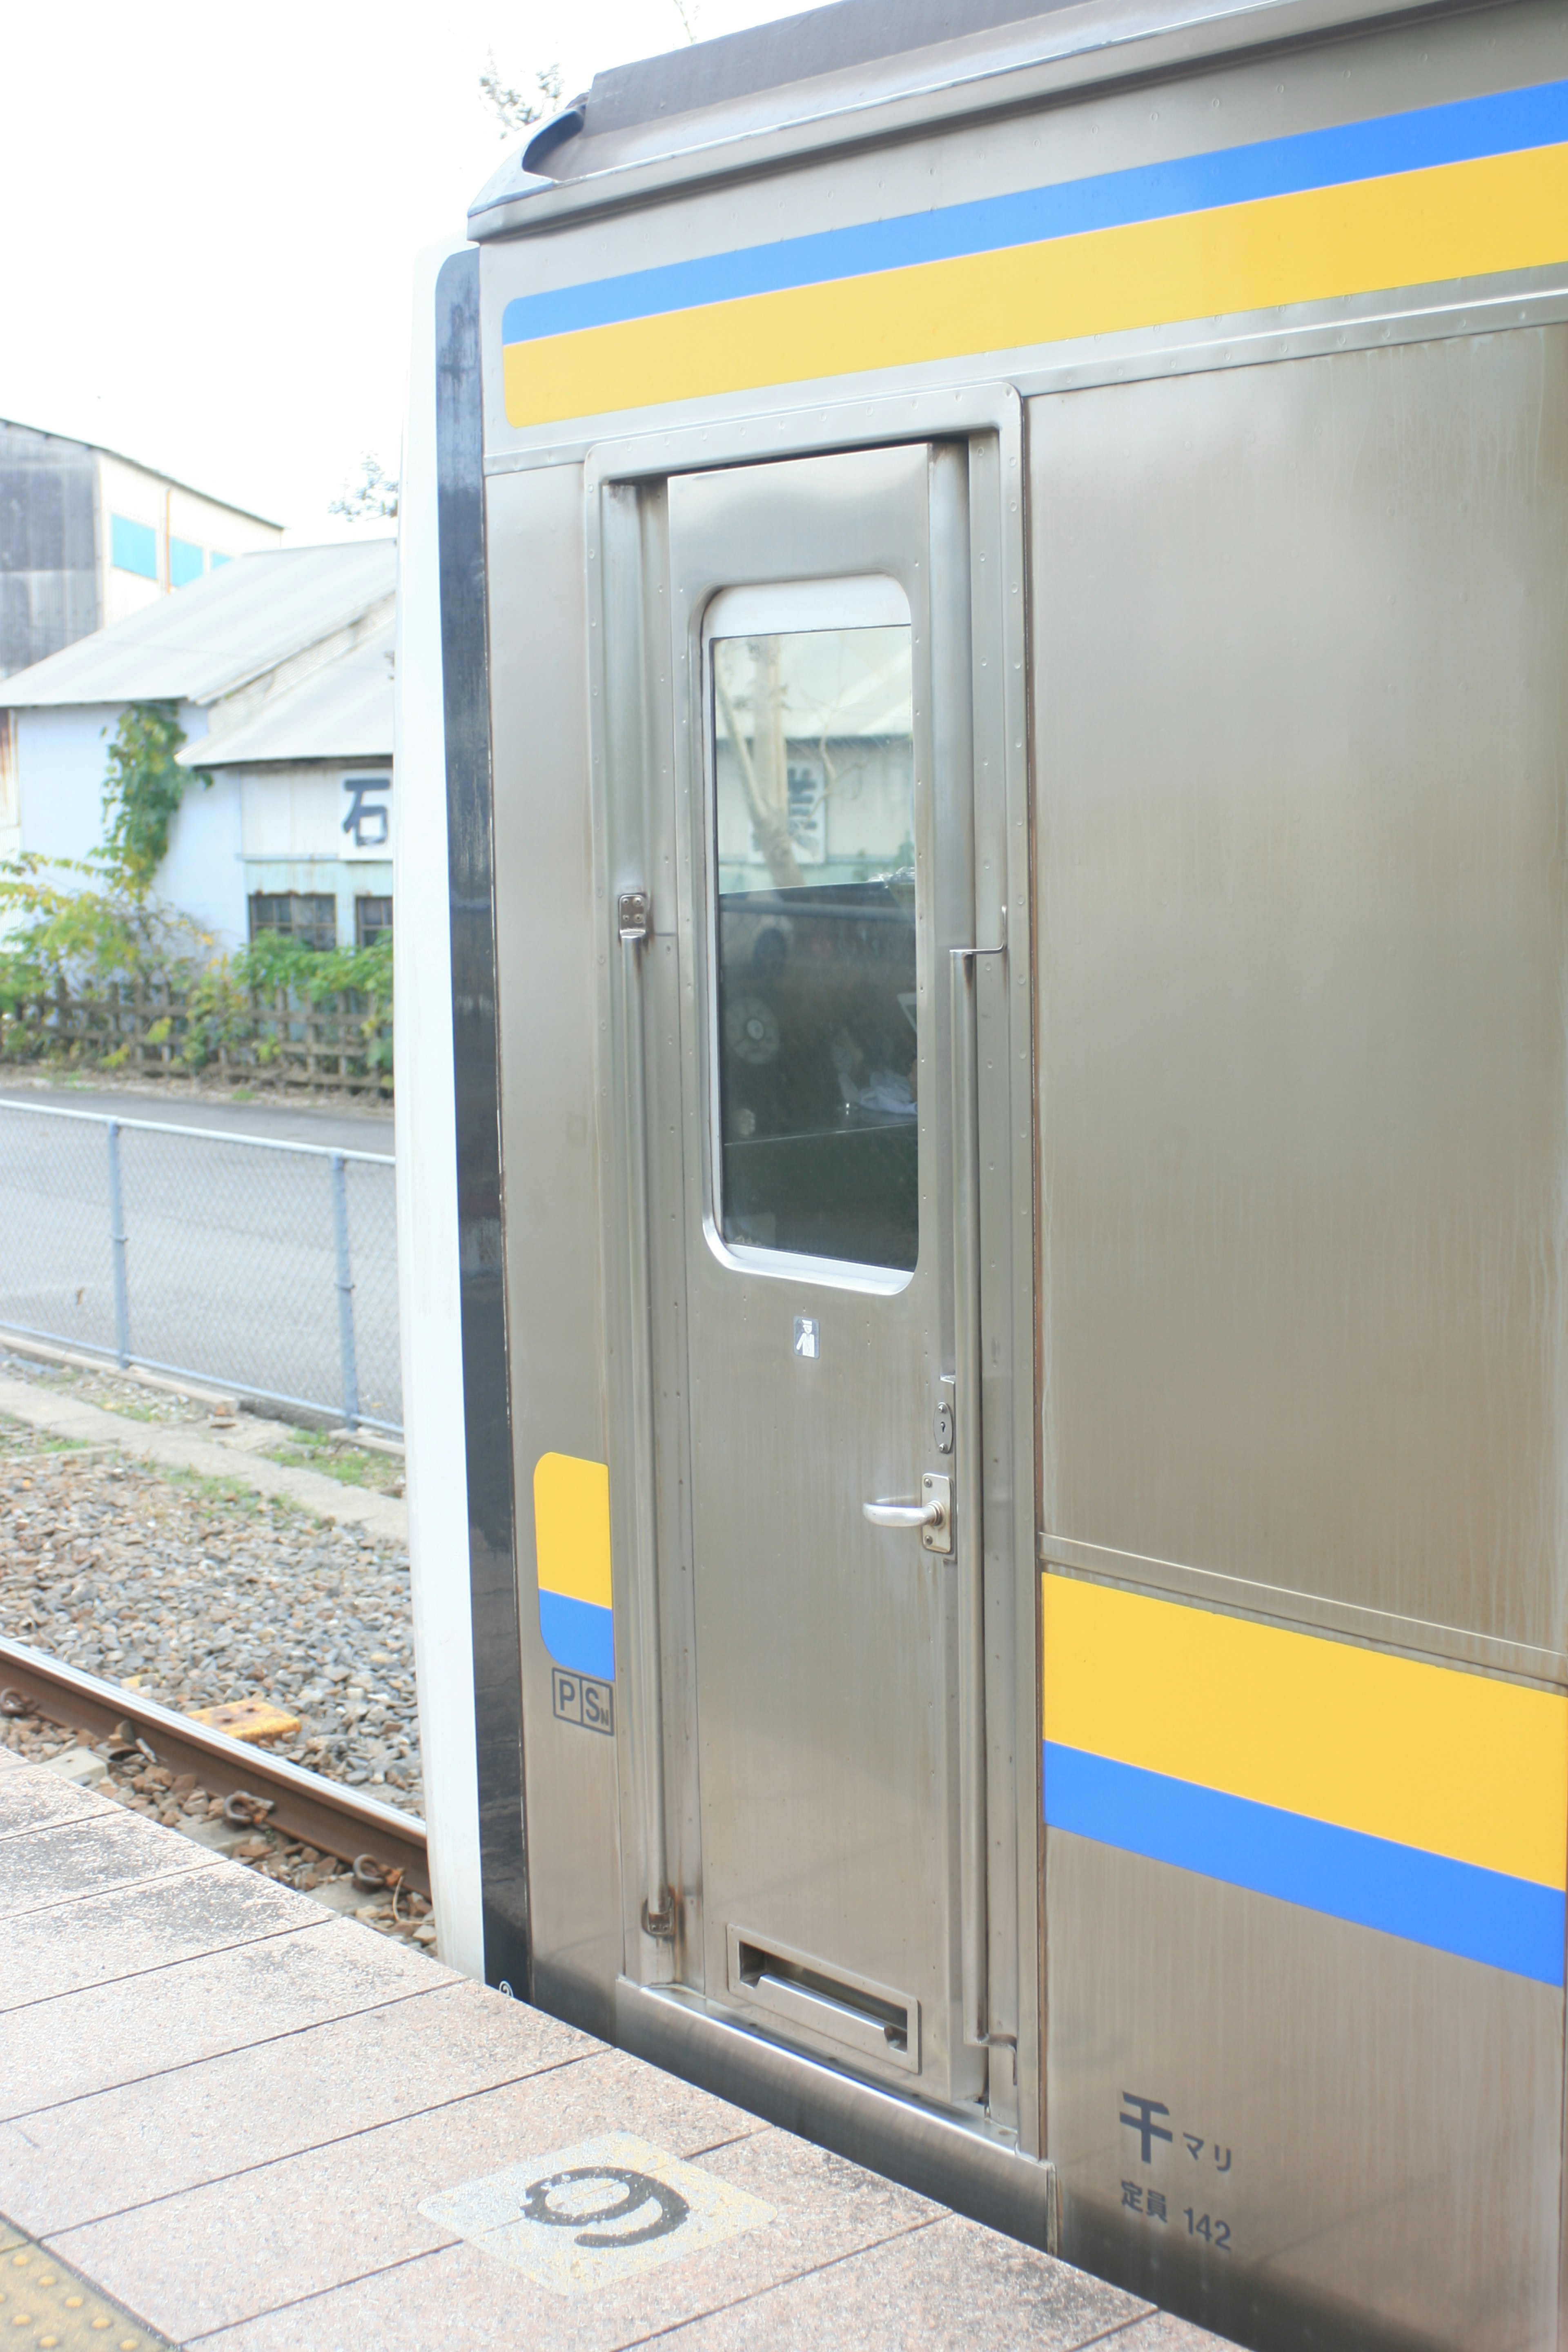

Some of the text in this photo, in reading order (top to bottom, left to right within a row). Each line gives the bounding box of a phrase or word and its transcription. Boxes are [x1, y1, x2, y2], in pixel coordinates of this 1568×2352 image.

[342, 778, 391, 847] 石
[1120, 2179, 1231, 2252] 定員 142
